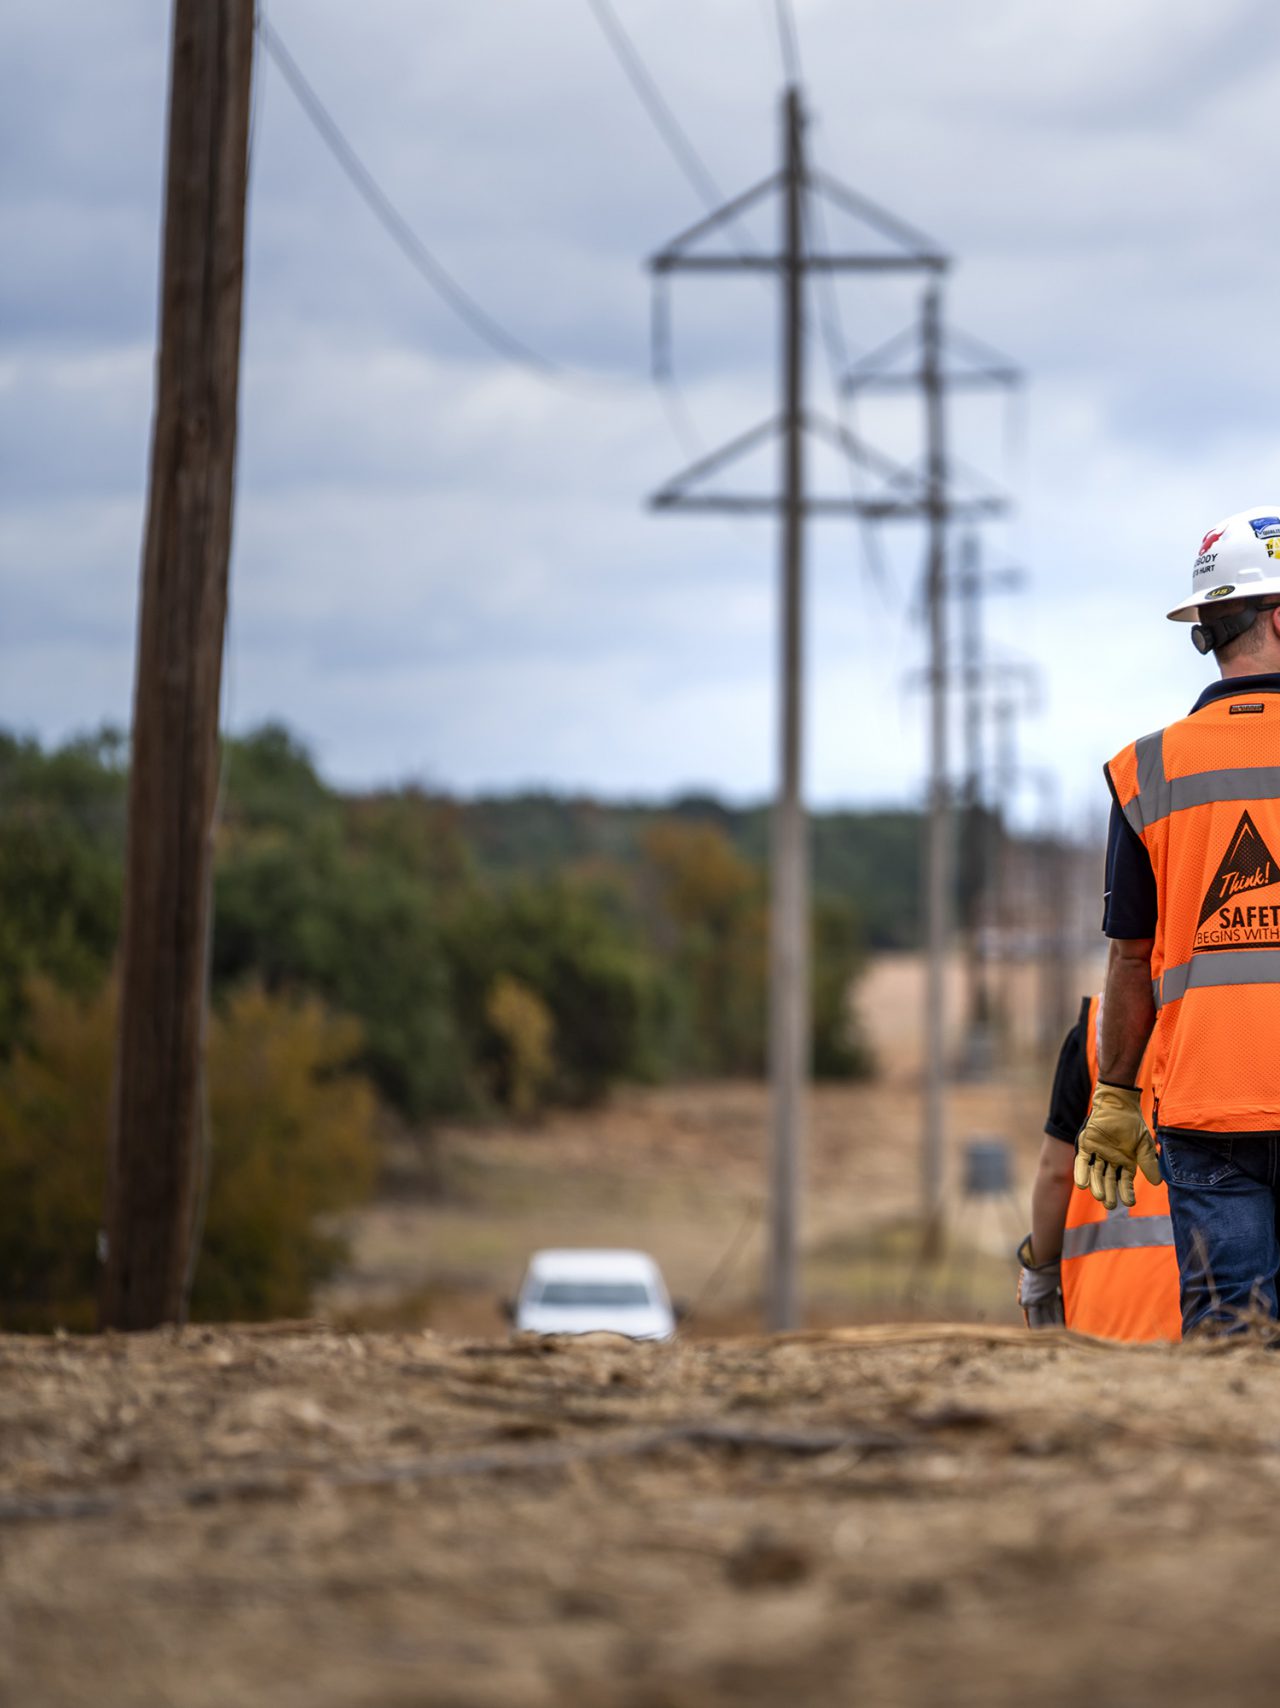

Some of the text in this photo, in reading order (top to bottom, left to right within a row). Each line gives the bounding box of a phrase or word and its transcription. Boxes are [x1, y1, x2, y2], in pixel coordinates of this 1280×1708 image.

[1220, 861, 1270, 898] Think!
[1197, 929, 1240, 944] BEGINS
[1244, 928, 1280, 940] WITH
